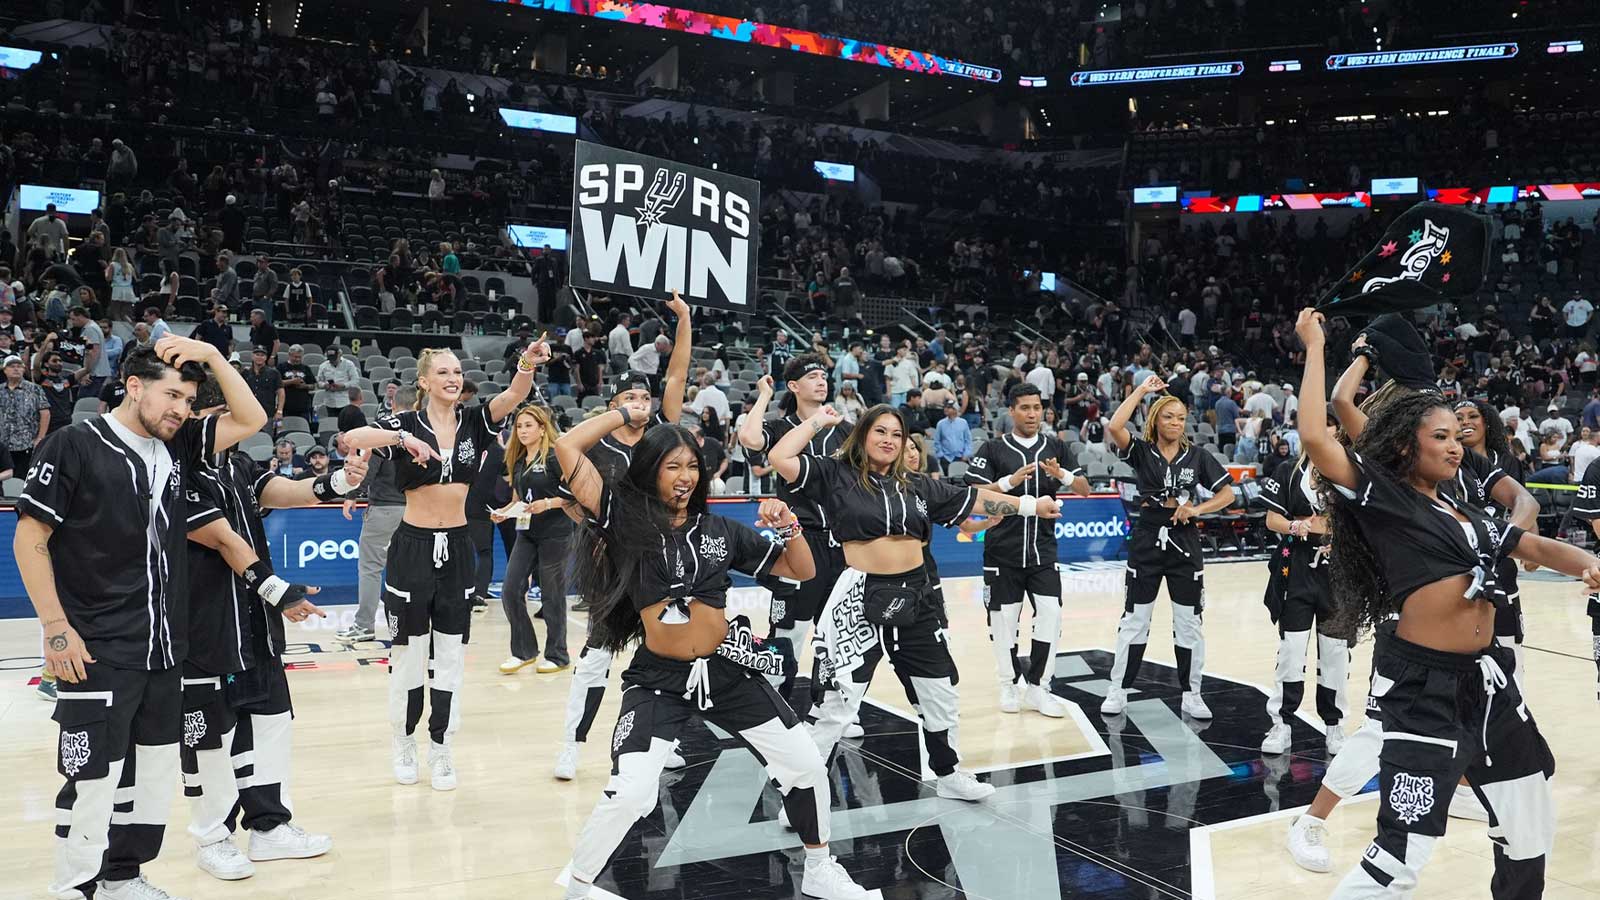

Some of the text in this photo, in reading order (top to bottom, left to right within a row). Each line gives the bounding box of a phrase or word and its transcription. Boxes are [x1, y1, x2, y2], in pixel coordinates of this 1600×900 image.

[1347, 46, 1506, 66] WESTERN CONFERENCE FINALS
[965, 66, 993, 79] FINALS
[1089, 65, 1233, 82] WESTERN CONFERENCE FINALS
[579, 163, 750, 238] SPURS
[579, 207, 749, 305] WIN
[351, 339, 361, 354] 8
[971, 457, 987, 469] SG
[1265, 478, 1281, 495] SG
[1576, 485, 1597, 499] SG
[1054, 516, 1124, 540] peacock
[1393, 772, 1433, 795] HYPE
[1389, 789, 1434, 808] SQUAD
